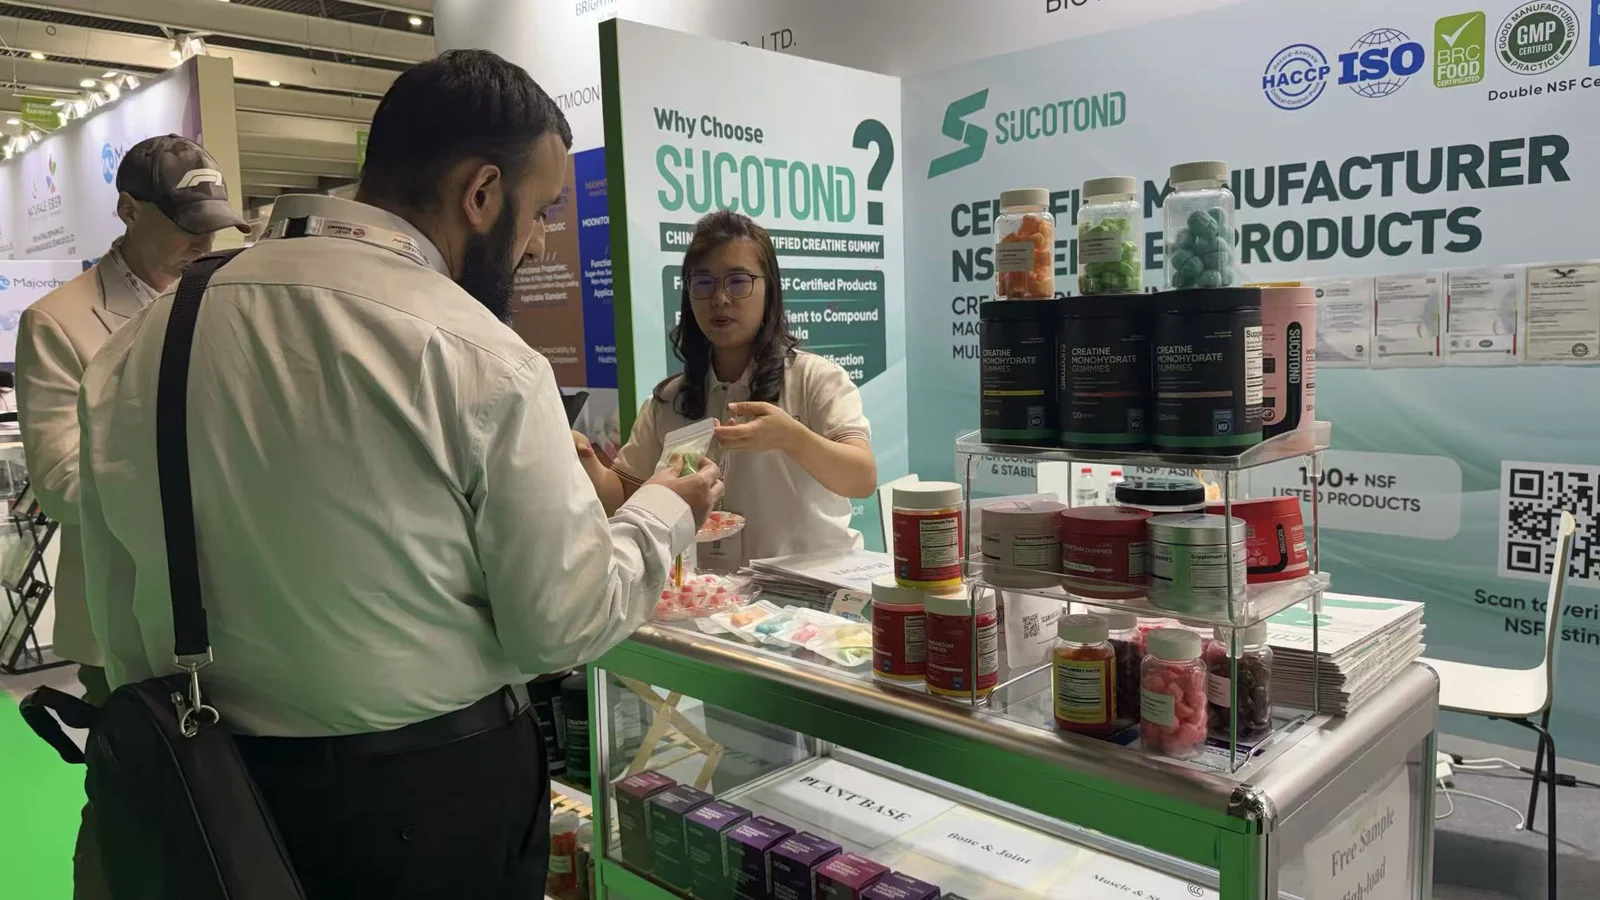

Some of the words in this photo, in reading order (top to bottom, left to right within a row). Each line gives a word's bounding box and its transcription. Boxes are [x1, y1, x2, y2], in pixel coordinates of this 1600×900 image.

[1499, 22, 1513, 49] GOOD
[1511, 3, 1575, 39] MANUFACTURING
[1516, 20, 1557, 46] GMP
[1437, 45, 1481, 66] BRC
[1518, 43, 1553, 56] CERTIFIED
[1338, 42, 1425, 85] ISO
[1437, 60, 1480, 80] FOOD
[1510, 53, 1562, 72] PRACTICE
[1262, 66, 1331, 89] HACCP
[1488, 84, 1543, 101] Double
[1547, 79, 1577, 93] NSF
[653, 107, 697, 139] Why
[700, 115, 764, 144] Choose
[995, 91, 1127, 145] SUCOTOND
[656, 144, 856, 223] SUCOTOND
[802, 237, 847, 252] CREATINE
[848, 241, 880, 253] GUMMY
[952, 247, 994, 282] NS
[1235, 207, 1483, 265] RODUCTS
[792, 278, 834, 292] Certified
[837, 279, 878, 292] Products
[810, 311, 822, 323] to
[824, 308, 878, 324] Compound
[983, 349, 1011, 357] CREATINE
[1072, 347, 1111, 356] CREATINE
[1072, 355, 1137, 364] MONOHYDRATE
[1156, 345, 1192, 354] CREATINE
[1156, 352, 1223, 362] MONOHYDRATE
[1289, 328, 1301, 384] SUCOTOND
[983, 356, 1037, 364] MONOHYDRATE
[1072, 364, 1111, 373] GUMMIES
[1157, 363, 1193, 372] GUMMIES
[1216, 423, 1228, 431] NSF
[991, 464, 999, 474] &
[1365, 475, 1397, 487] NSF
[1327, 491, 1421, 512] PRODUCTS
[1474, 588, 1526, 611] Scan
[1505, 616, 1545, 637] NSF
[1561, 628, 1600, 646] stin
[799, 776, 858, 803] PLANT
[858, 797, 912, 823] BASE
[946, 831, 980, 848] Bone
[982, 843, 996, 852] &
[996, 847, 1034, 866] Joint
[1331, 843, 1357, 878] Free
[1359, 807, 1395, 851] Sample
[1092, 874, 1131, 892] Muscle
